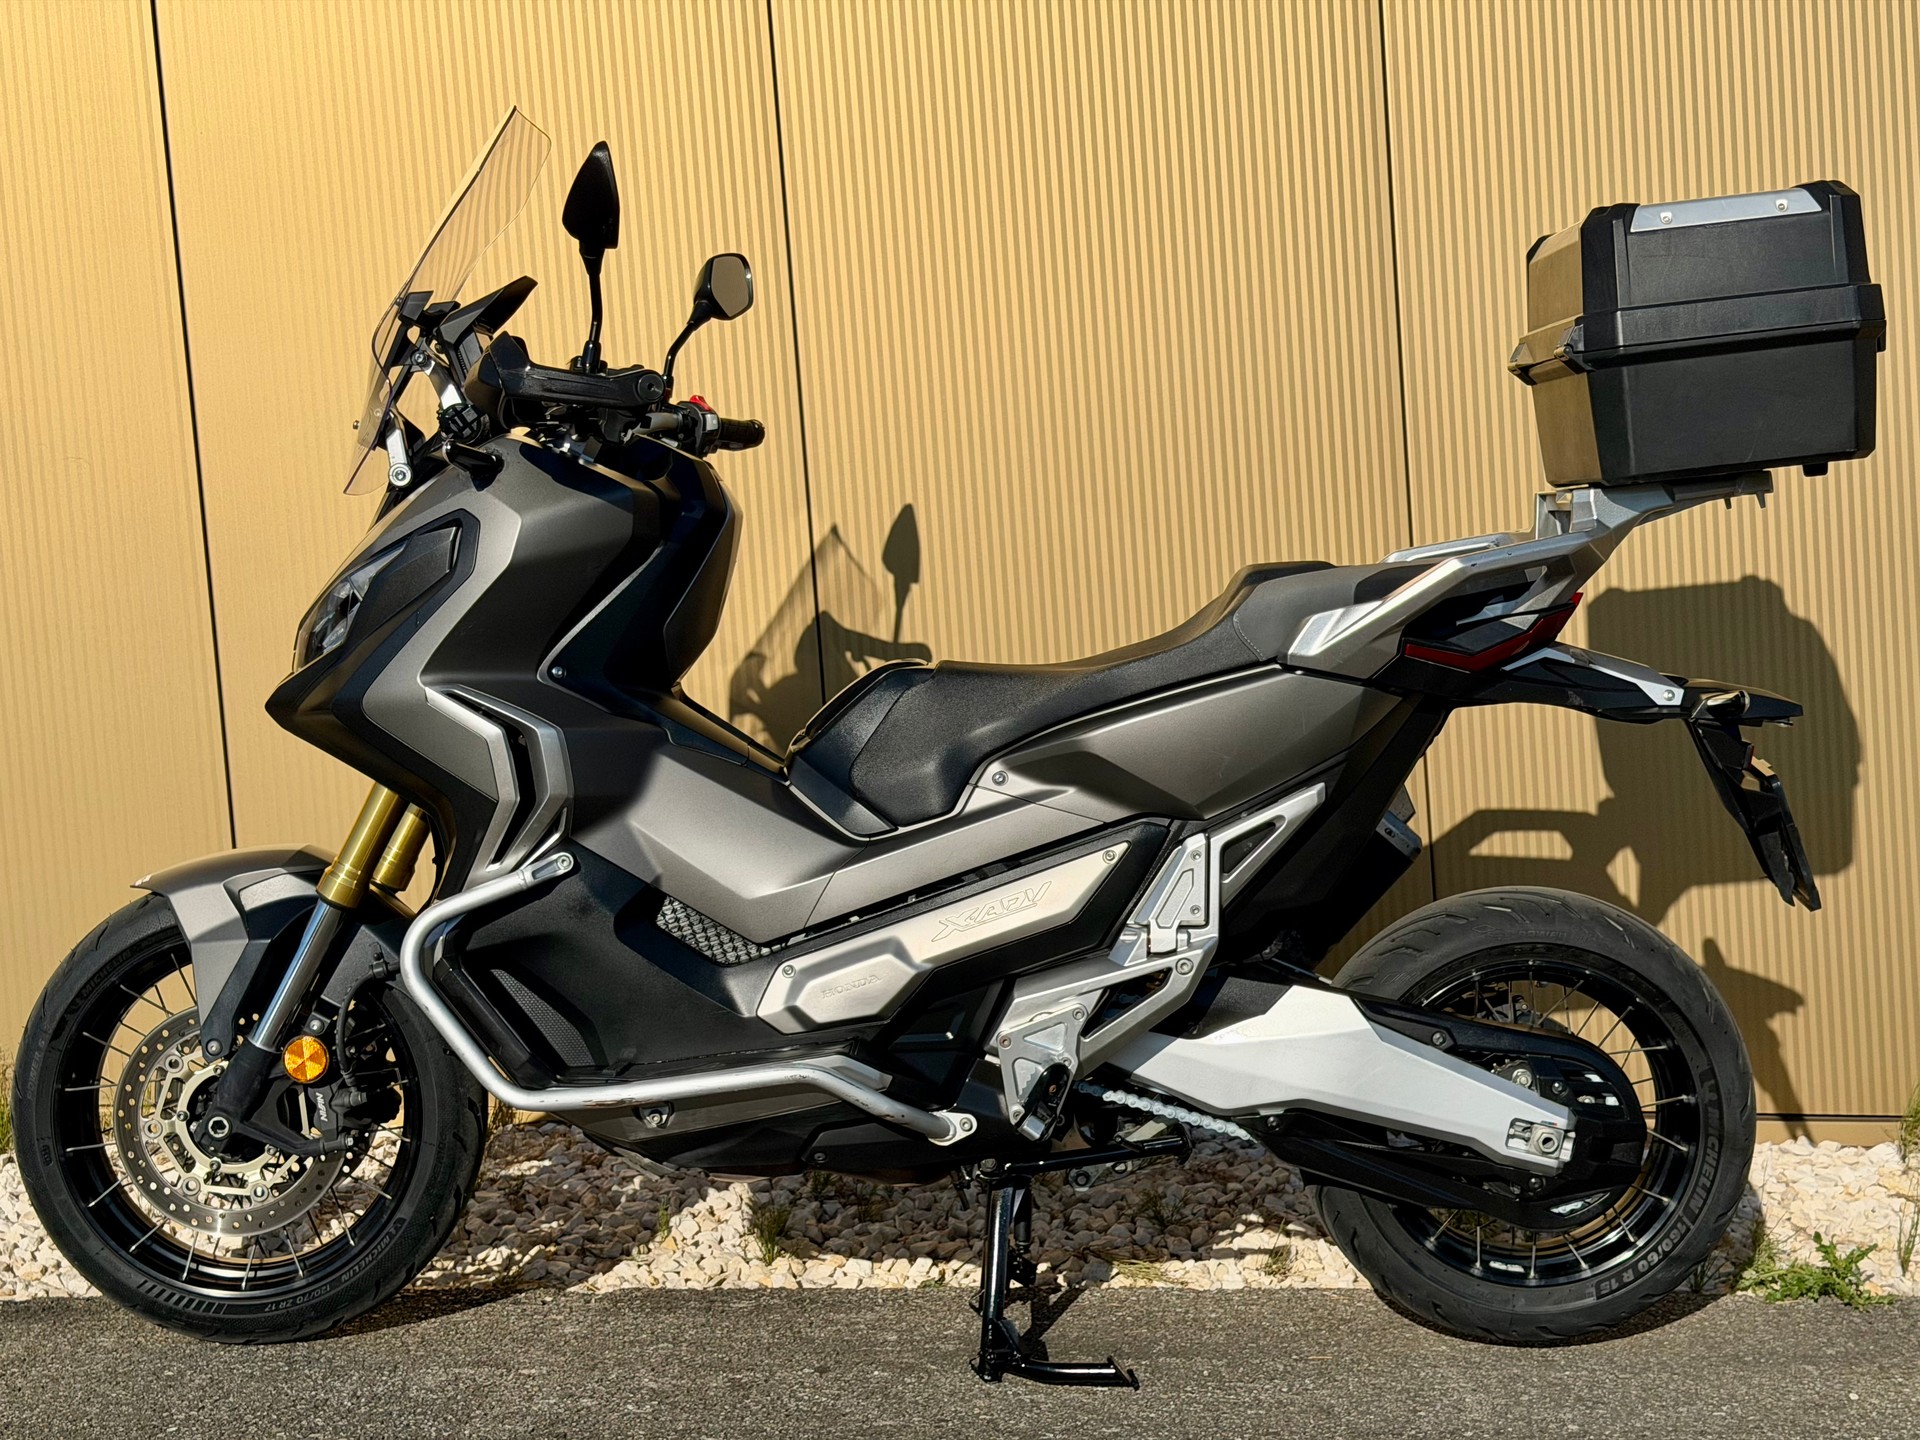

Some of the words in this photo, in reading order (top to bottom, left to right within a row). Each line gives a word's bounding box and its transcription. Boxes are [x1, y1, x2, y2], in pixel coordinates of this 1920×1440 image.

[821, 973, 882, 1000] HONDA
[26, 1050, 43, 1100] POWER
[1690, 1108, 1721, 1214] MICHELIN
[1637, 1217, 1688, 1273] 160/60
[341, 1234, 391, 1283] MICHELIN
[1599, 1277, 1620, 1294] 15
[1621, 1269, 1636, 1284] R
[278, 1296, 294, 1309] ZR
[296, 1284, 332, 1306] 120/70
[264, 1303, 278, 1312] 17
